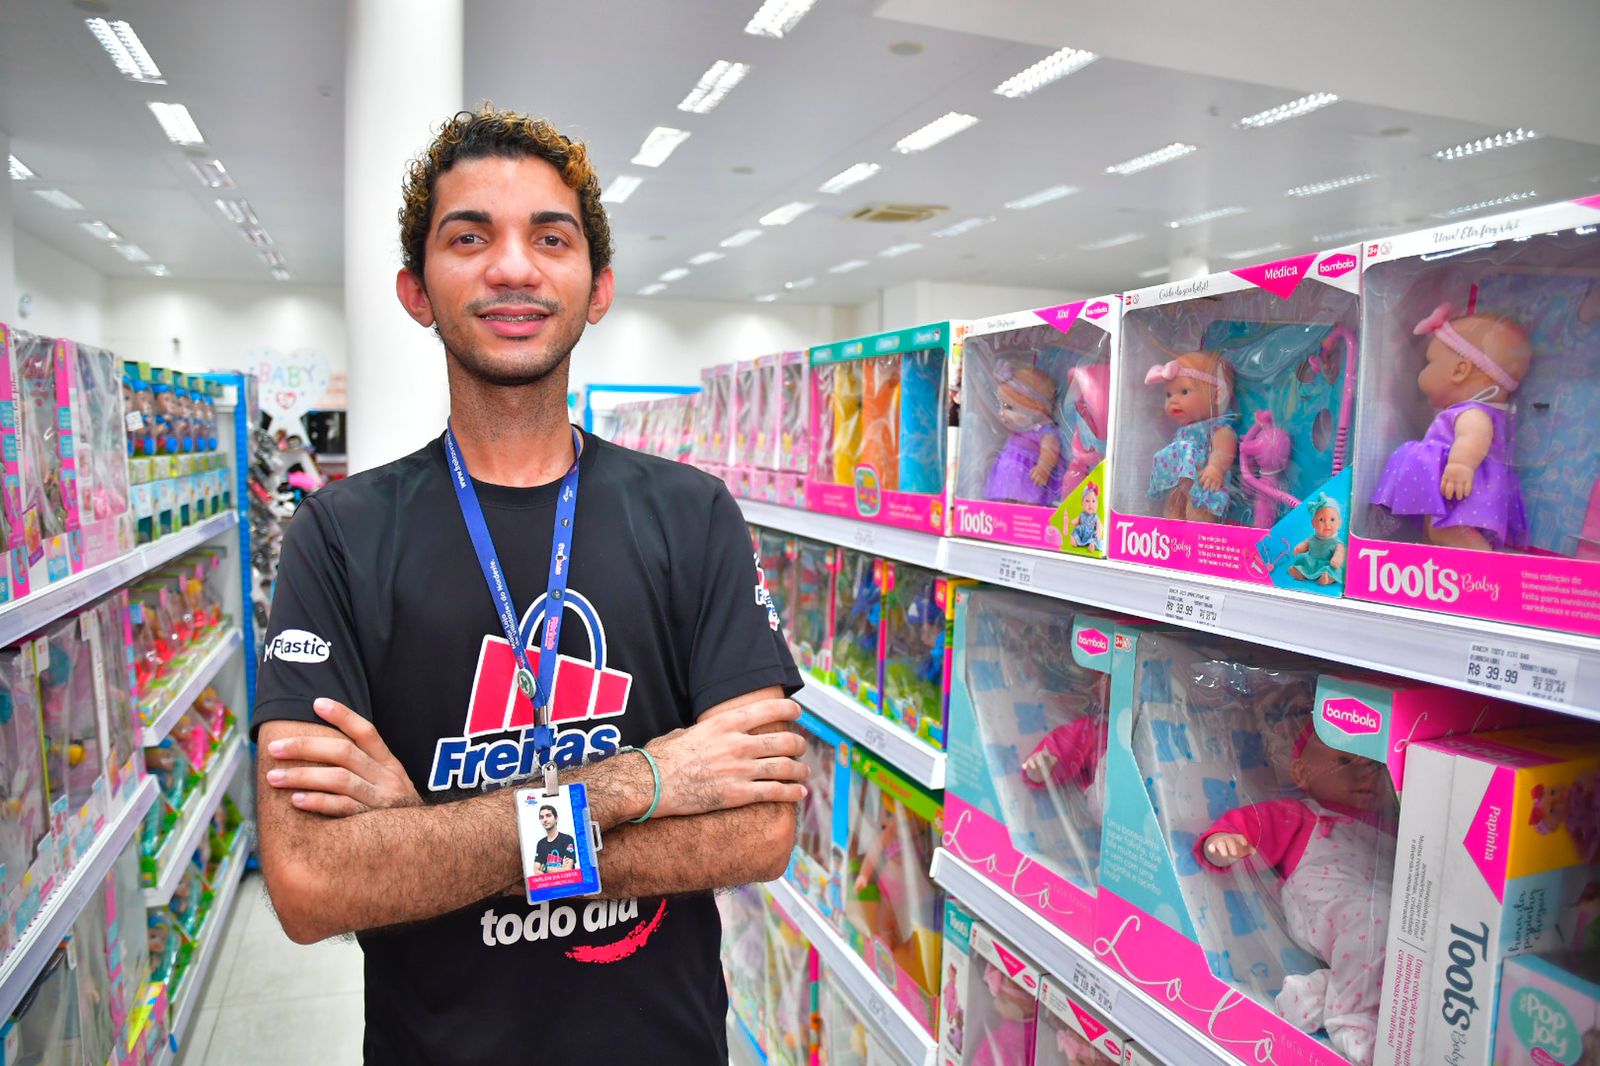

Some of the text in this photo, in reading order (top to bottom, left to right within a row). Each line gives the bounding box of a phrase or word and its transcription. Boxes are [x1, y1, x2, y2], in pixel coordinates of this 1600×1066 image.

[1263, 265, 1299, 281] Médica
[1319, 258, 1356, 274] bambola
[258, 362, 316, 388] BABY
[957, 505, 993, 535] Toots
[1116, 521, 1170, 561] Toots
[1170, 537, 1192, 558] Baby
[1358, 548, 1501, 603] Toots Baby
[501, 613, 510, 630] Loja
[1078, 633, 1108, 651] bambola
[1468, 662, 1481, 677] R$
[1485, 666, 1519, 685] 39.99
[1325, 702, 1378, 730] bambola
[430, 725, 620, 788] Freitas
[1484, 804, 1501, 862] Papinha
[480, 897, 639, 947] todo dia
[1393, 949, 1405, 998] carinhosas
[1402, 953, 1415, 995] lindinhas
[1413, 958, 1424, 980] Uma
[1399, 995, 1410, 1017] feita
[1409, 980, 1420, 1016] coleção
[1441, 921, 1491, 1066] Toots Baby
[1387, 1006, 1399, 1048] criativas!
[1397, 1016, 1407, 1039] para
[1408, 1015, 1417, 1028] de
